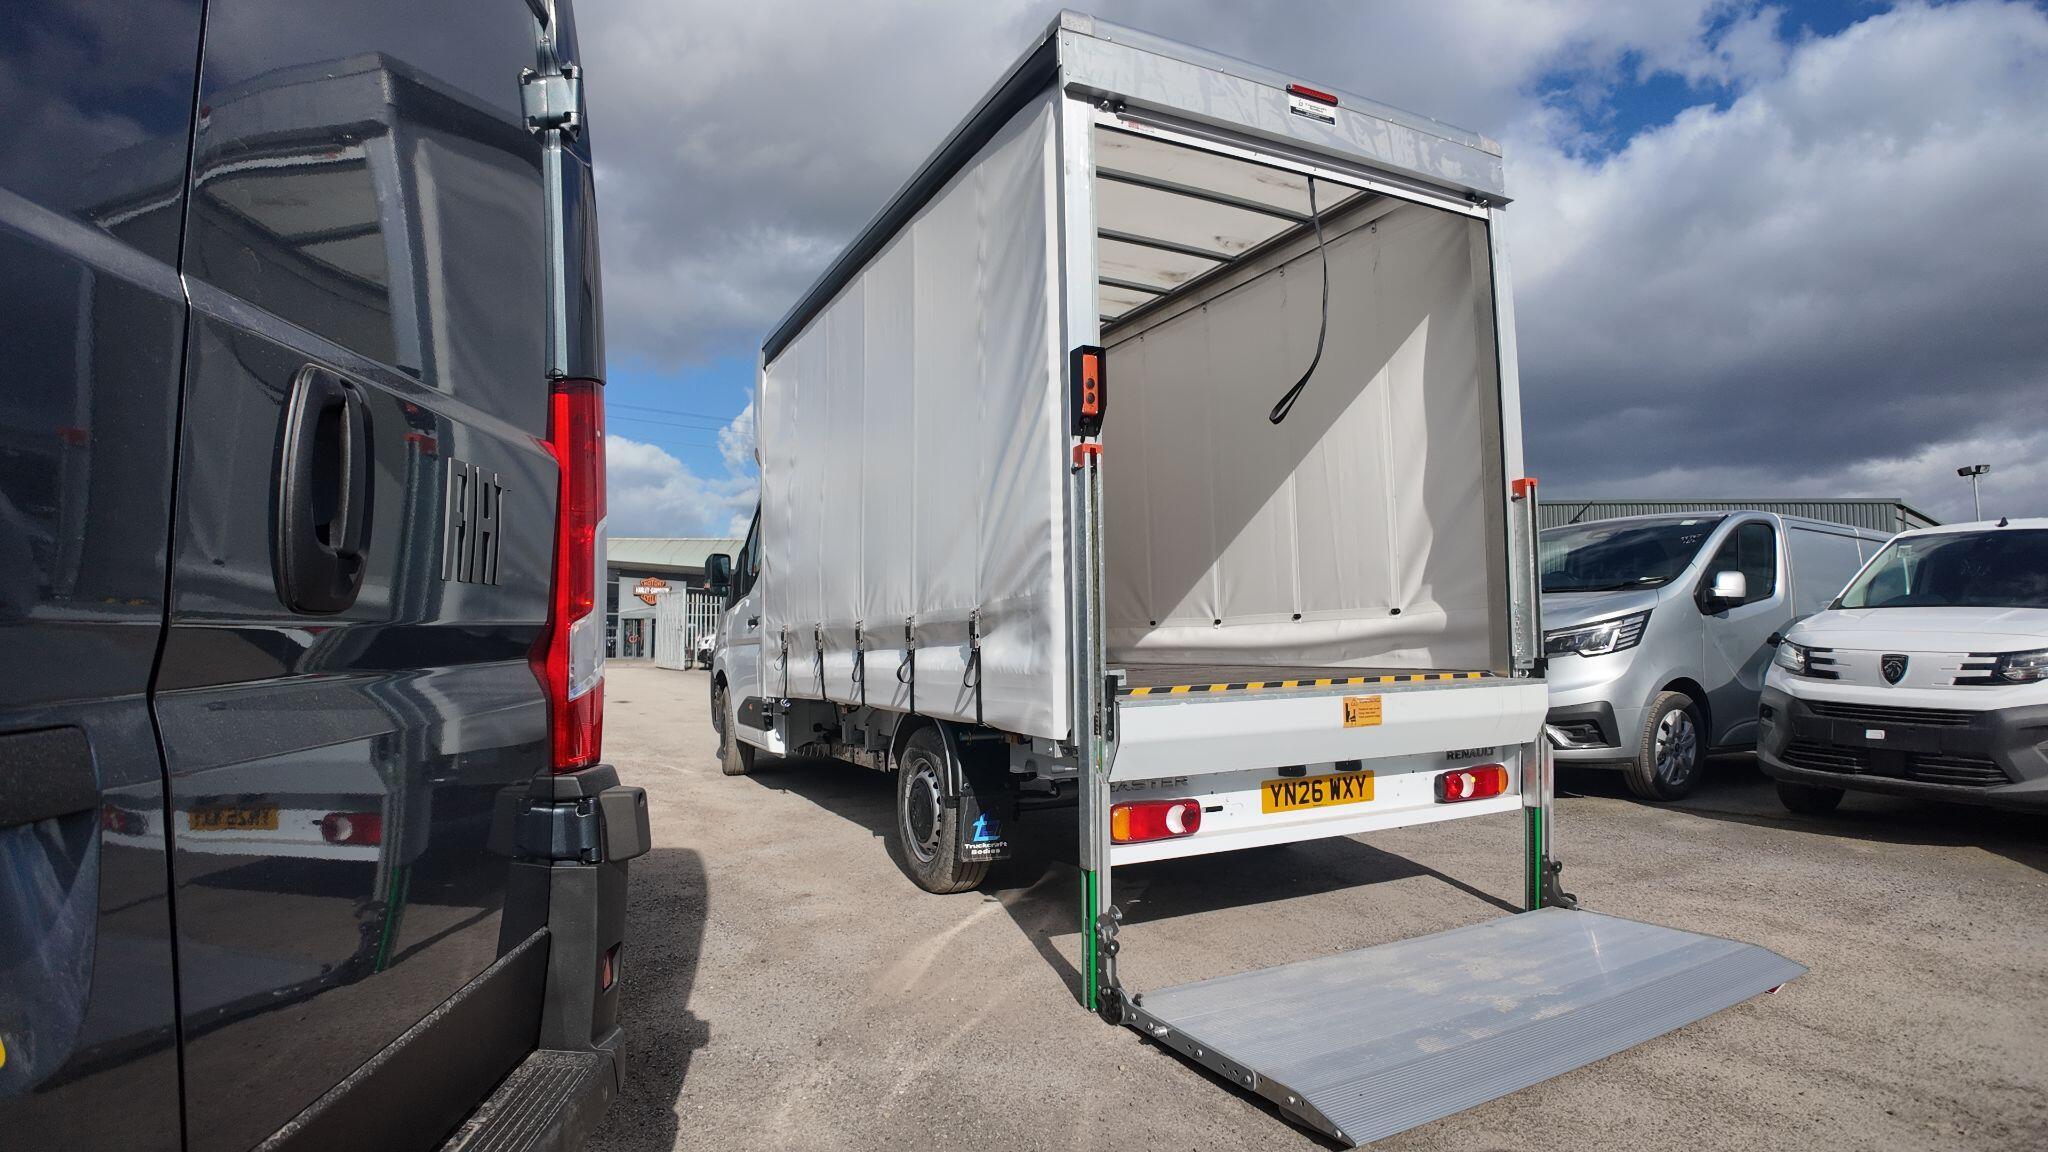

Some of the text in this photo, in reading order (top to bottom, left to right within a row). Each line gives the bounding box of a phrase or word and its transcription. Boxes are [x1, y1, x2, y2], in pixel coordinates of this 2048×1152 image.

[442, 457, 512, 586] FIAT
[1446, 746, 1496, 760] RENAULT
[1270, 774, 1366, 807] YN26 WXY
